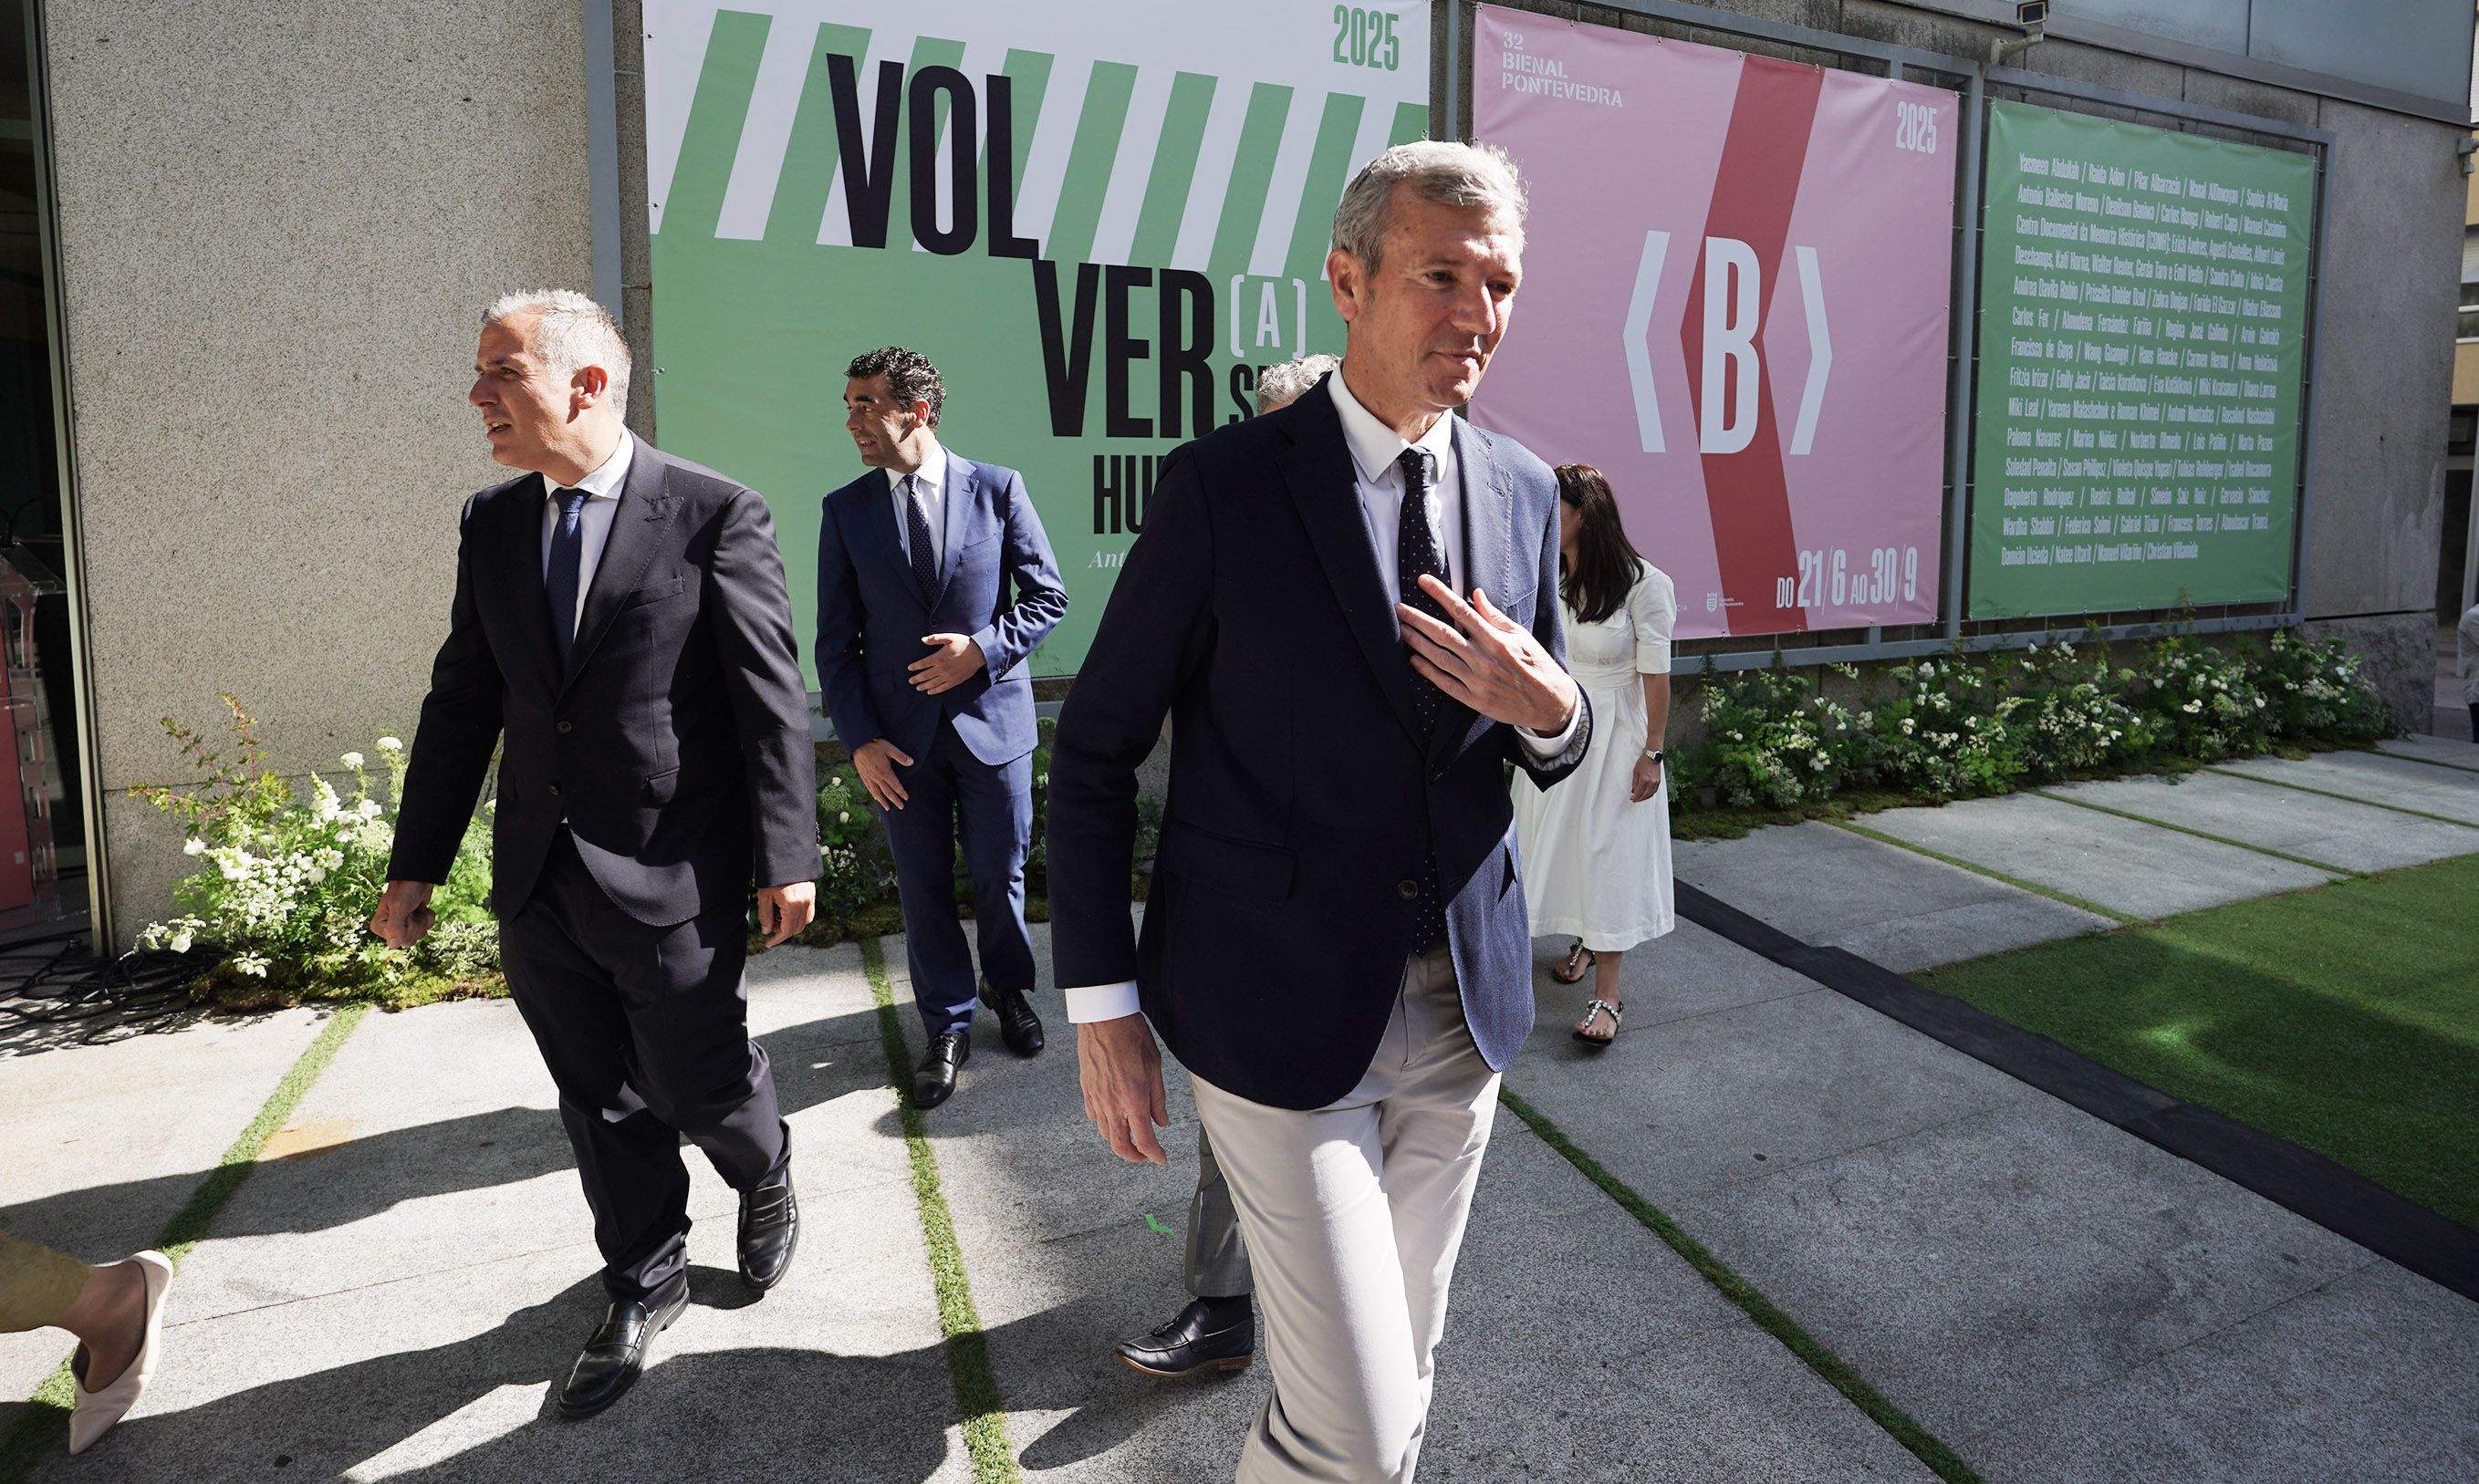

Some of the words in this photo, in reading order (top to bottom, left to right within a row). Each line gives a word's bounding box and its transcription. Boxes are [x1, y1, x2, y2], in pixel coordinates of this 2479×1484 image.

[1333, 5, 1400, 71] 2025
[1503, 31, 1524, 51] 32
[1502, 51, 1568, 78] BIENAL
[1502, 72, 1623, 108] PONTEVEDRA
[1895, 100, 1938, 155] 2025
[827, 54, 1038, 258] VOL
[2017, 182, 2044, 205] Antonio
[2160, 203, 2180, 223] Carlos
[2015, 214, 2039, 235] Centro
[2039, 217, 2078, 241] Documental
[2078, 222, 2088, 242] da
[2013, 275, 2037, 296] Andrea
[2167, 265, 2173, 280] e
[2011, 306, 2034, 327] Carlos
[1031, 259, 1215, 439] VER
[2010, 337, 2043, 358] Francisco
[2045, 338, 2055, 358] de
[2056, 339, 2074, 362] Goya
[2109, 405, 2116, 420] e
[2005, 428, 2032, 446] Paloma
[1776, 576, 1795, 608] DO
[1797, 545, 1847, 615] 21/6
[1849, 575, 1868, 605] AO
[1870, 544, 1918, 612] 30/9
